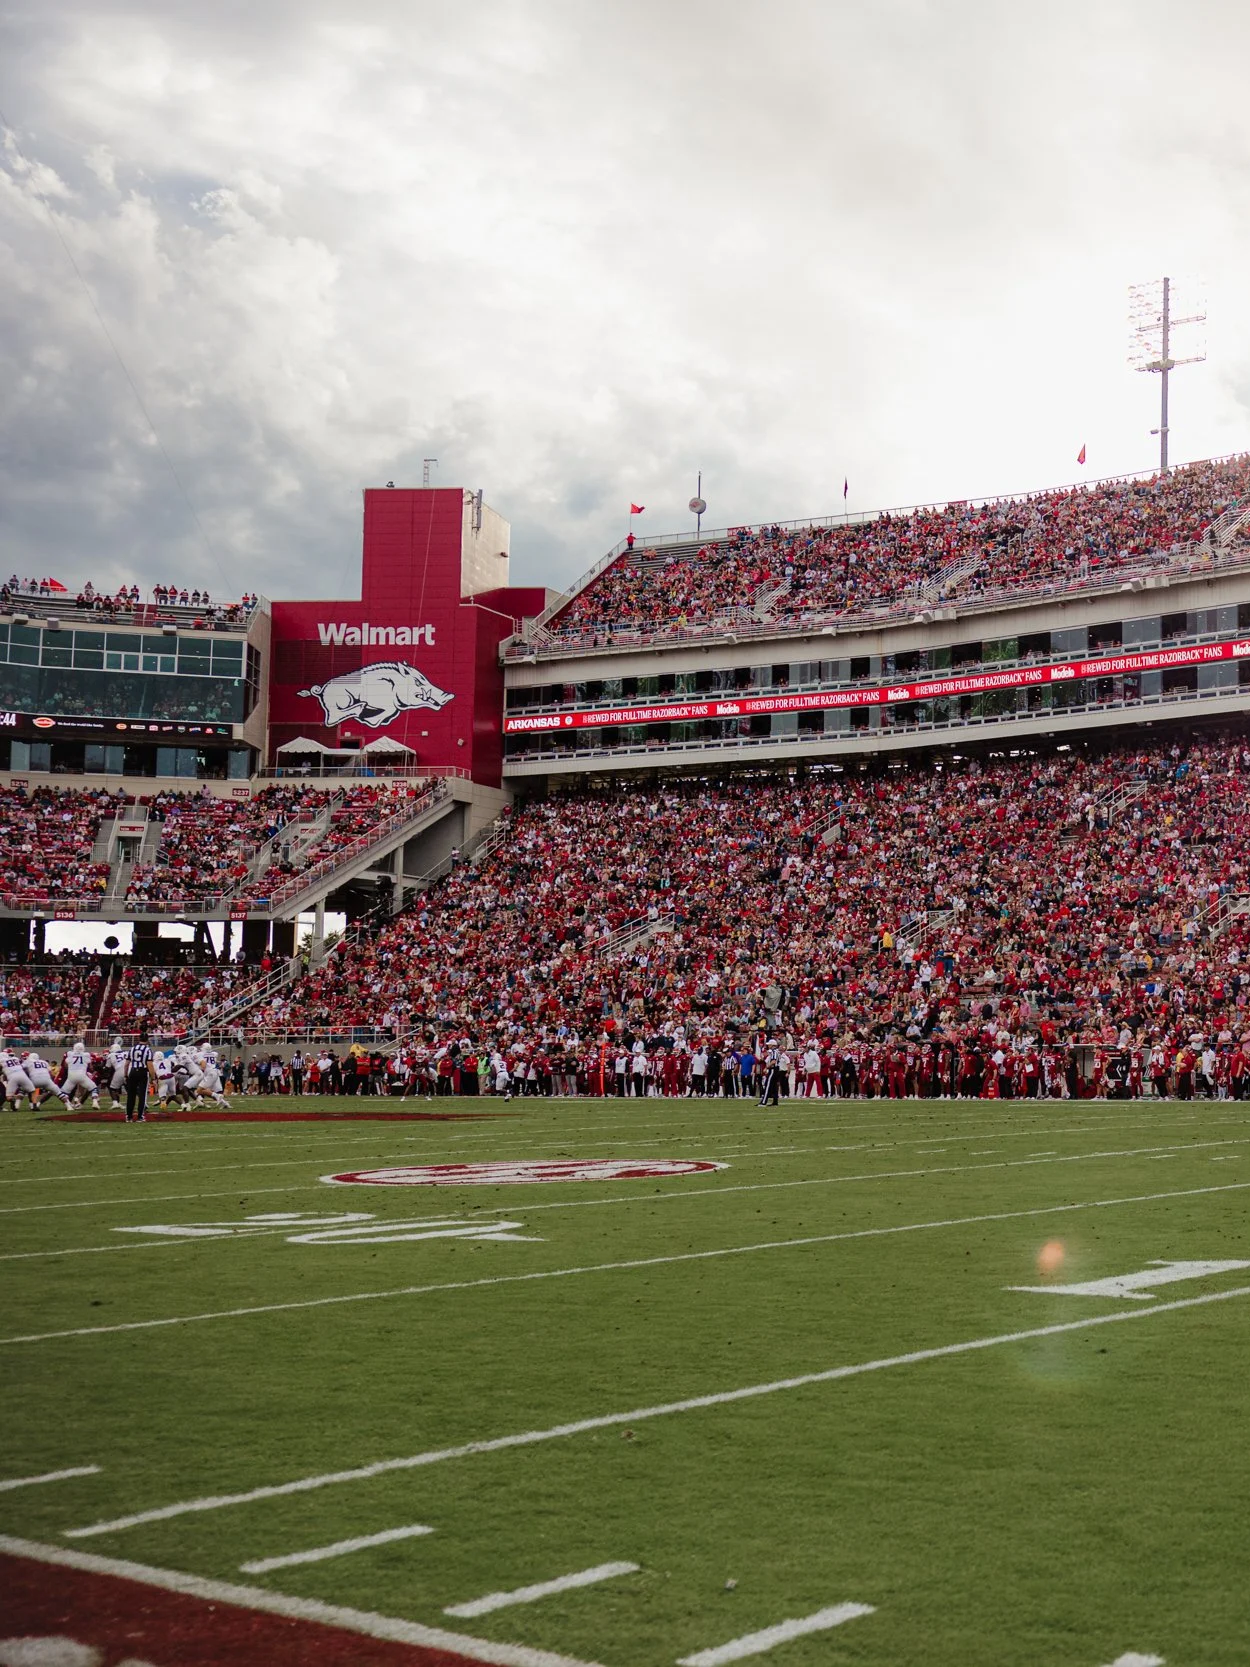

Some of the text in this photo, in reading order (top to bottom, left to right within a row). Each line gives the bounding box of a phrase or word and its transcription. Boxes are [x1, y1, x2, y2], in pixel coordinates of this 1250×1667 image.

[317, 622, 436, 646] Walmart
[1111, 660, 1125, 670] FOR
[1204, 646, 1222, 658] FANS
[1051, 666, 1075, 679] Modelo
[942, 682, 955, 692] FOR
[1025, 670, 1042, 680] FANS
[775, 701, 788, 709] FOR
[862, 692, 879, 701] FANS
[887, 688, 909, 700] Modelo
[610, 712, 622, 721] FOR
[692, 705, 708, 715] FANS
[717, 702, 739, 714] Modelo
[507, 717, 560, 730] ARKANSAS
[73, 1056, 84, 1065] 71
